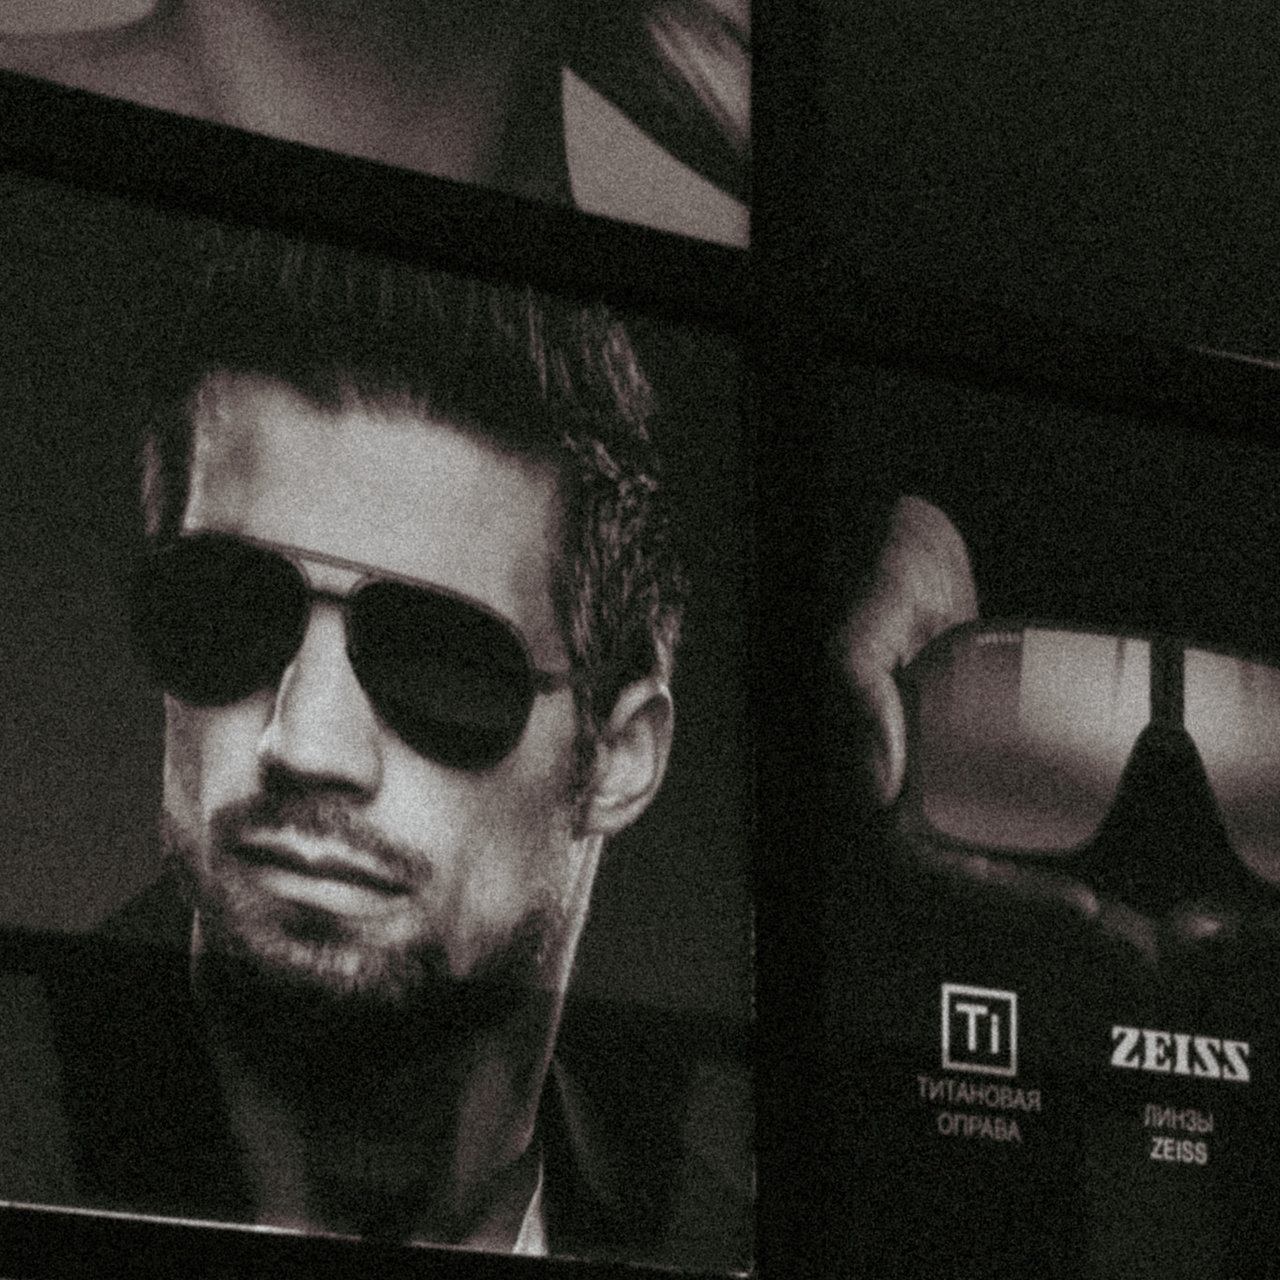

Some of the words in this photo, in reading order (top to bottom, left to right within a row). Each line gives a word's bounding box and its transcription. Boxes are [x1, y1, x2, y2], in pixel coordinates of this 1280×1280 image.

[1111, 1026, 1250, 1081] ZEISS
[917, 1075, 1041, 1111] ТИТАНОВАЯ
[938, 1112, 1021, 1141] ОПРАВА
[1144, 1104, 1214, 1133] ЛИНЗЫ
[1150, 1137, 1208, 1165] ZEISS
